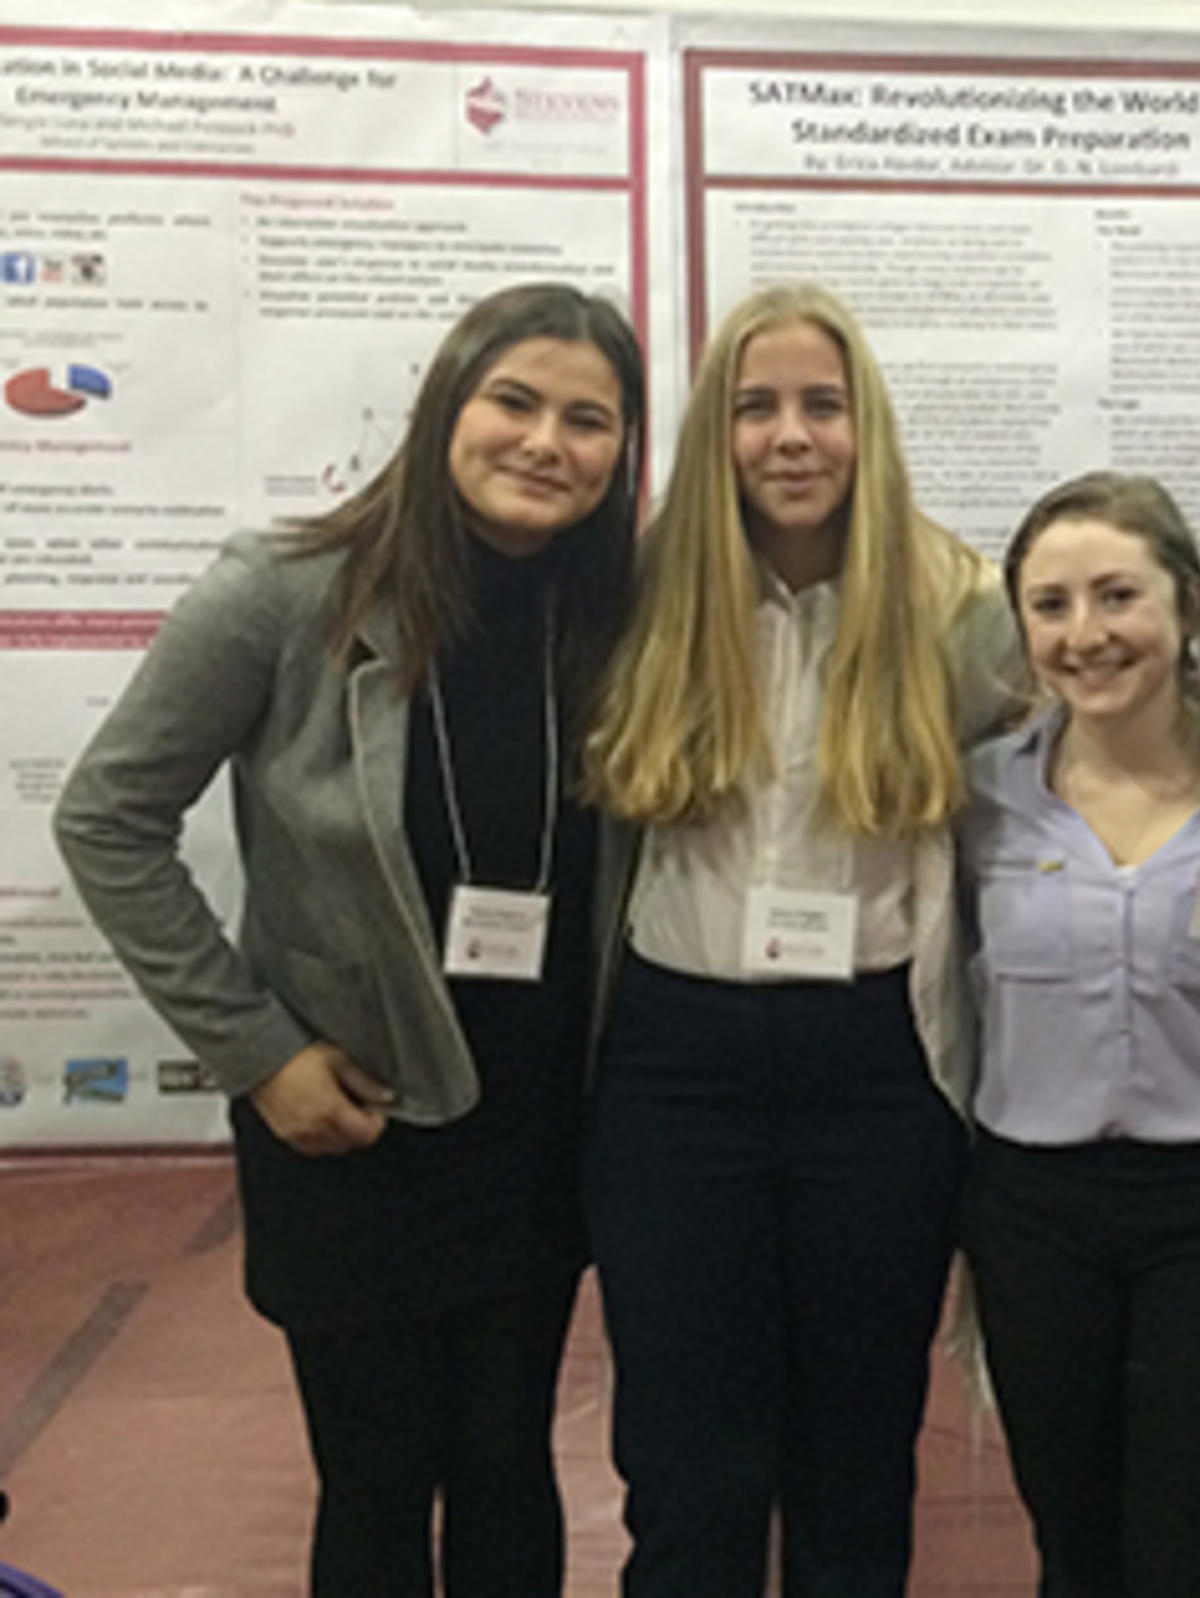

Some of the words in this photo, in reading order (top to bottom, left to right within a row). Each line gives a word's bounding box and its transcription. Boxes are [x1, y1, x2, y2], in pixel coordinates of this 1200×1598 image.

[61, 58, 82, 77] in
[87, 60, 148, 80] Social
[154, 62, 224, 82] Media:
[238, 64, 256, 82] A
[260, 65, 359, 91] Challenge
[366, 68, 397, 88] for
[15, 86, 130, 110] Emergency
[748, 81, 863, 106] SATMax:
[871, 84, 1066, 115] Revolutionizing
[1072, 90, 1115, 113] the
[1120, 91, 1200, 115] World
[790, 121, 959, 148] Standardized
[967, 124, 1036, 149] Exam
[1042, 127, 1191, 154] Preparation
